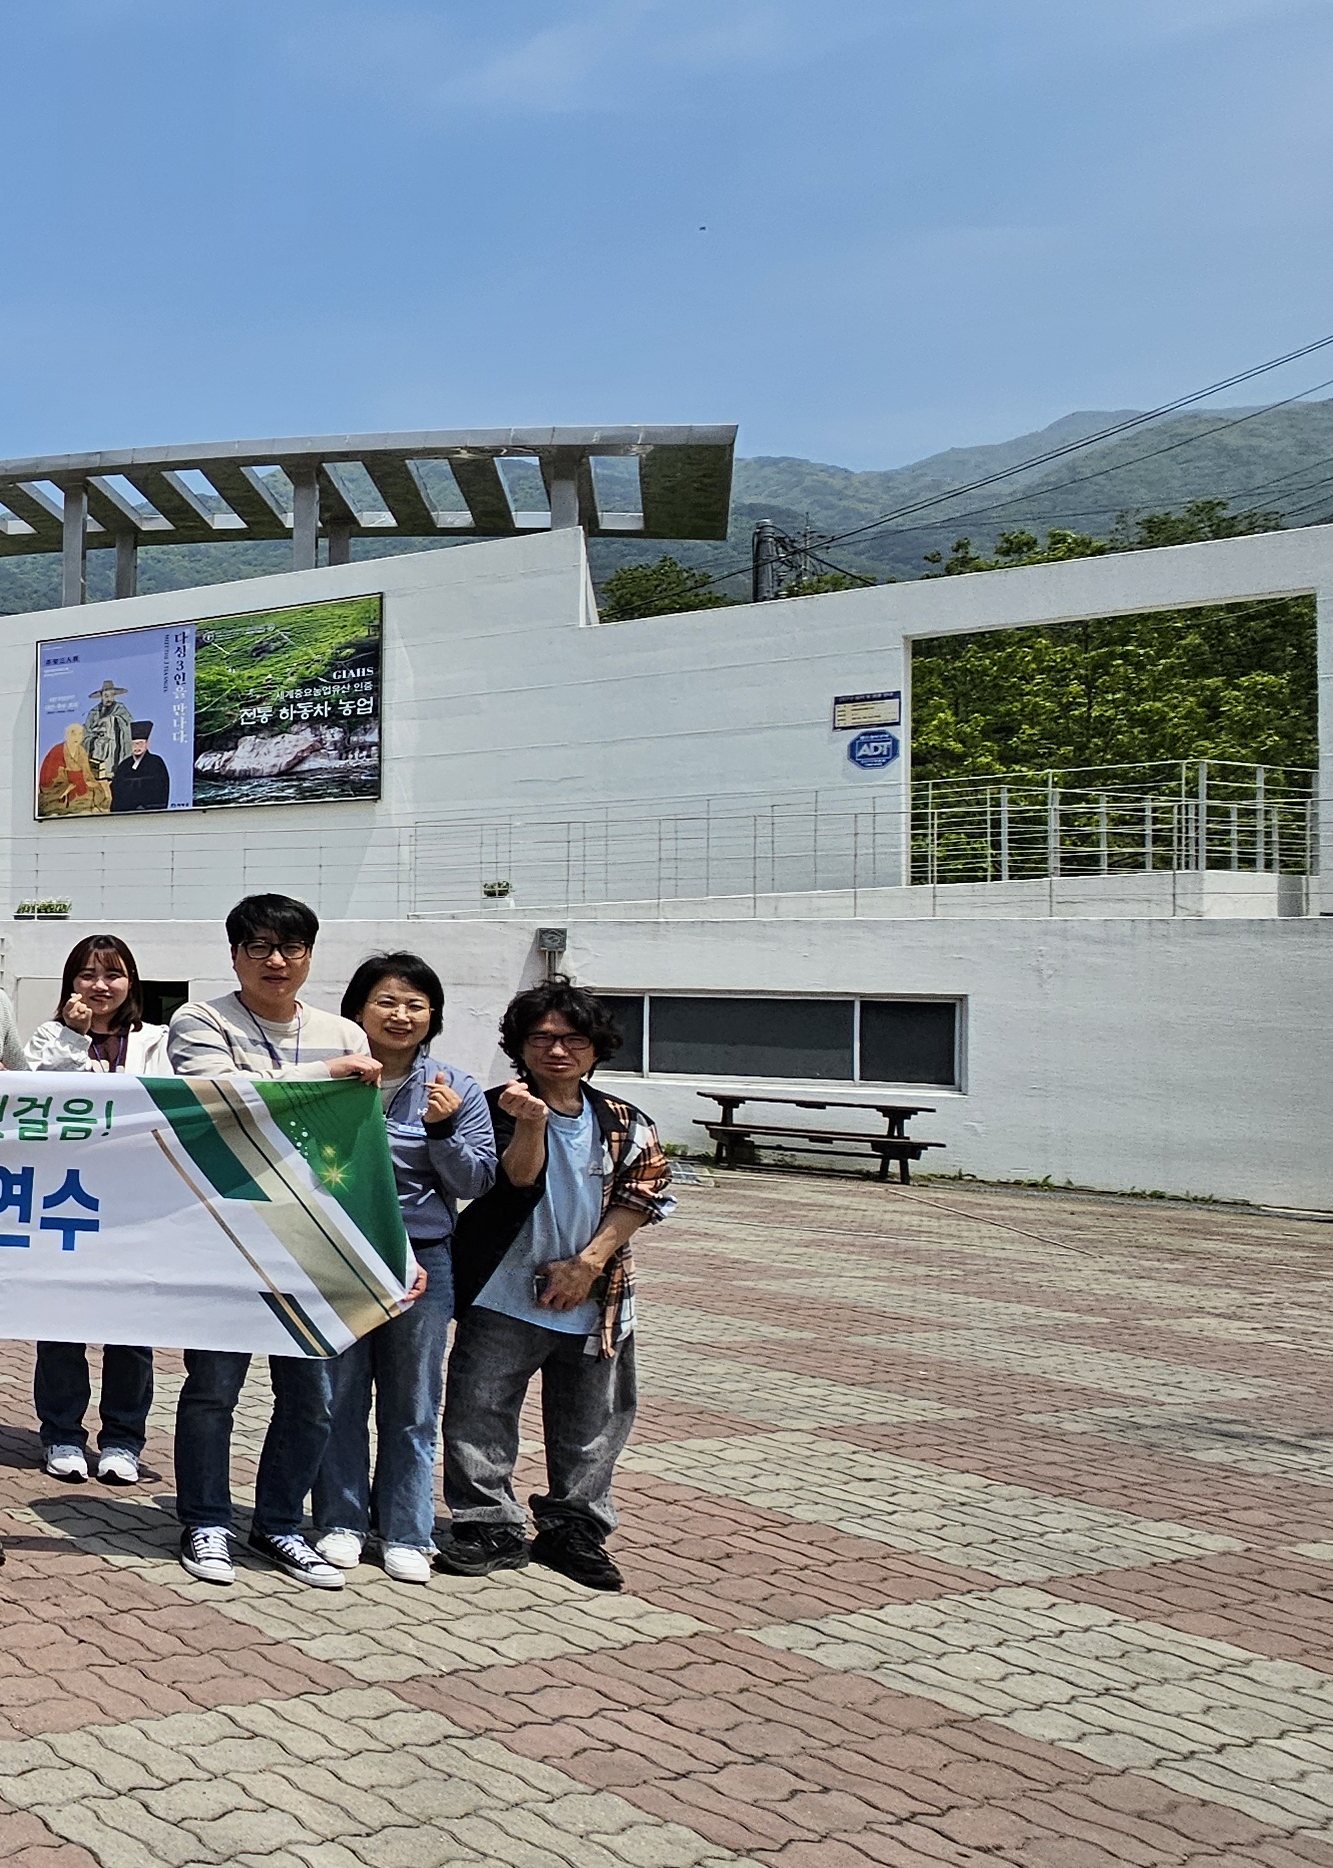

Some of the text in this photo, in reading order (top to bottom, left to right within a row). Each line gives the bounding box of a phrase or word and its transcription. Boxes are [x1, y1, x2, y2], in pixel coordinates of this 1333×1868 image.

[332, 666, 374, 680] GIAHS
[239, 696, 374, 726] 전통 하동차 농업
[857, 742, 892, 757] ADT
